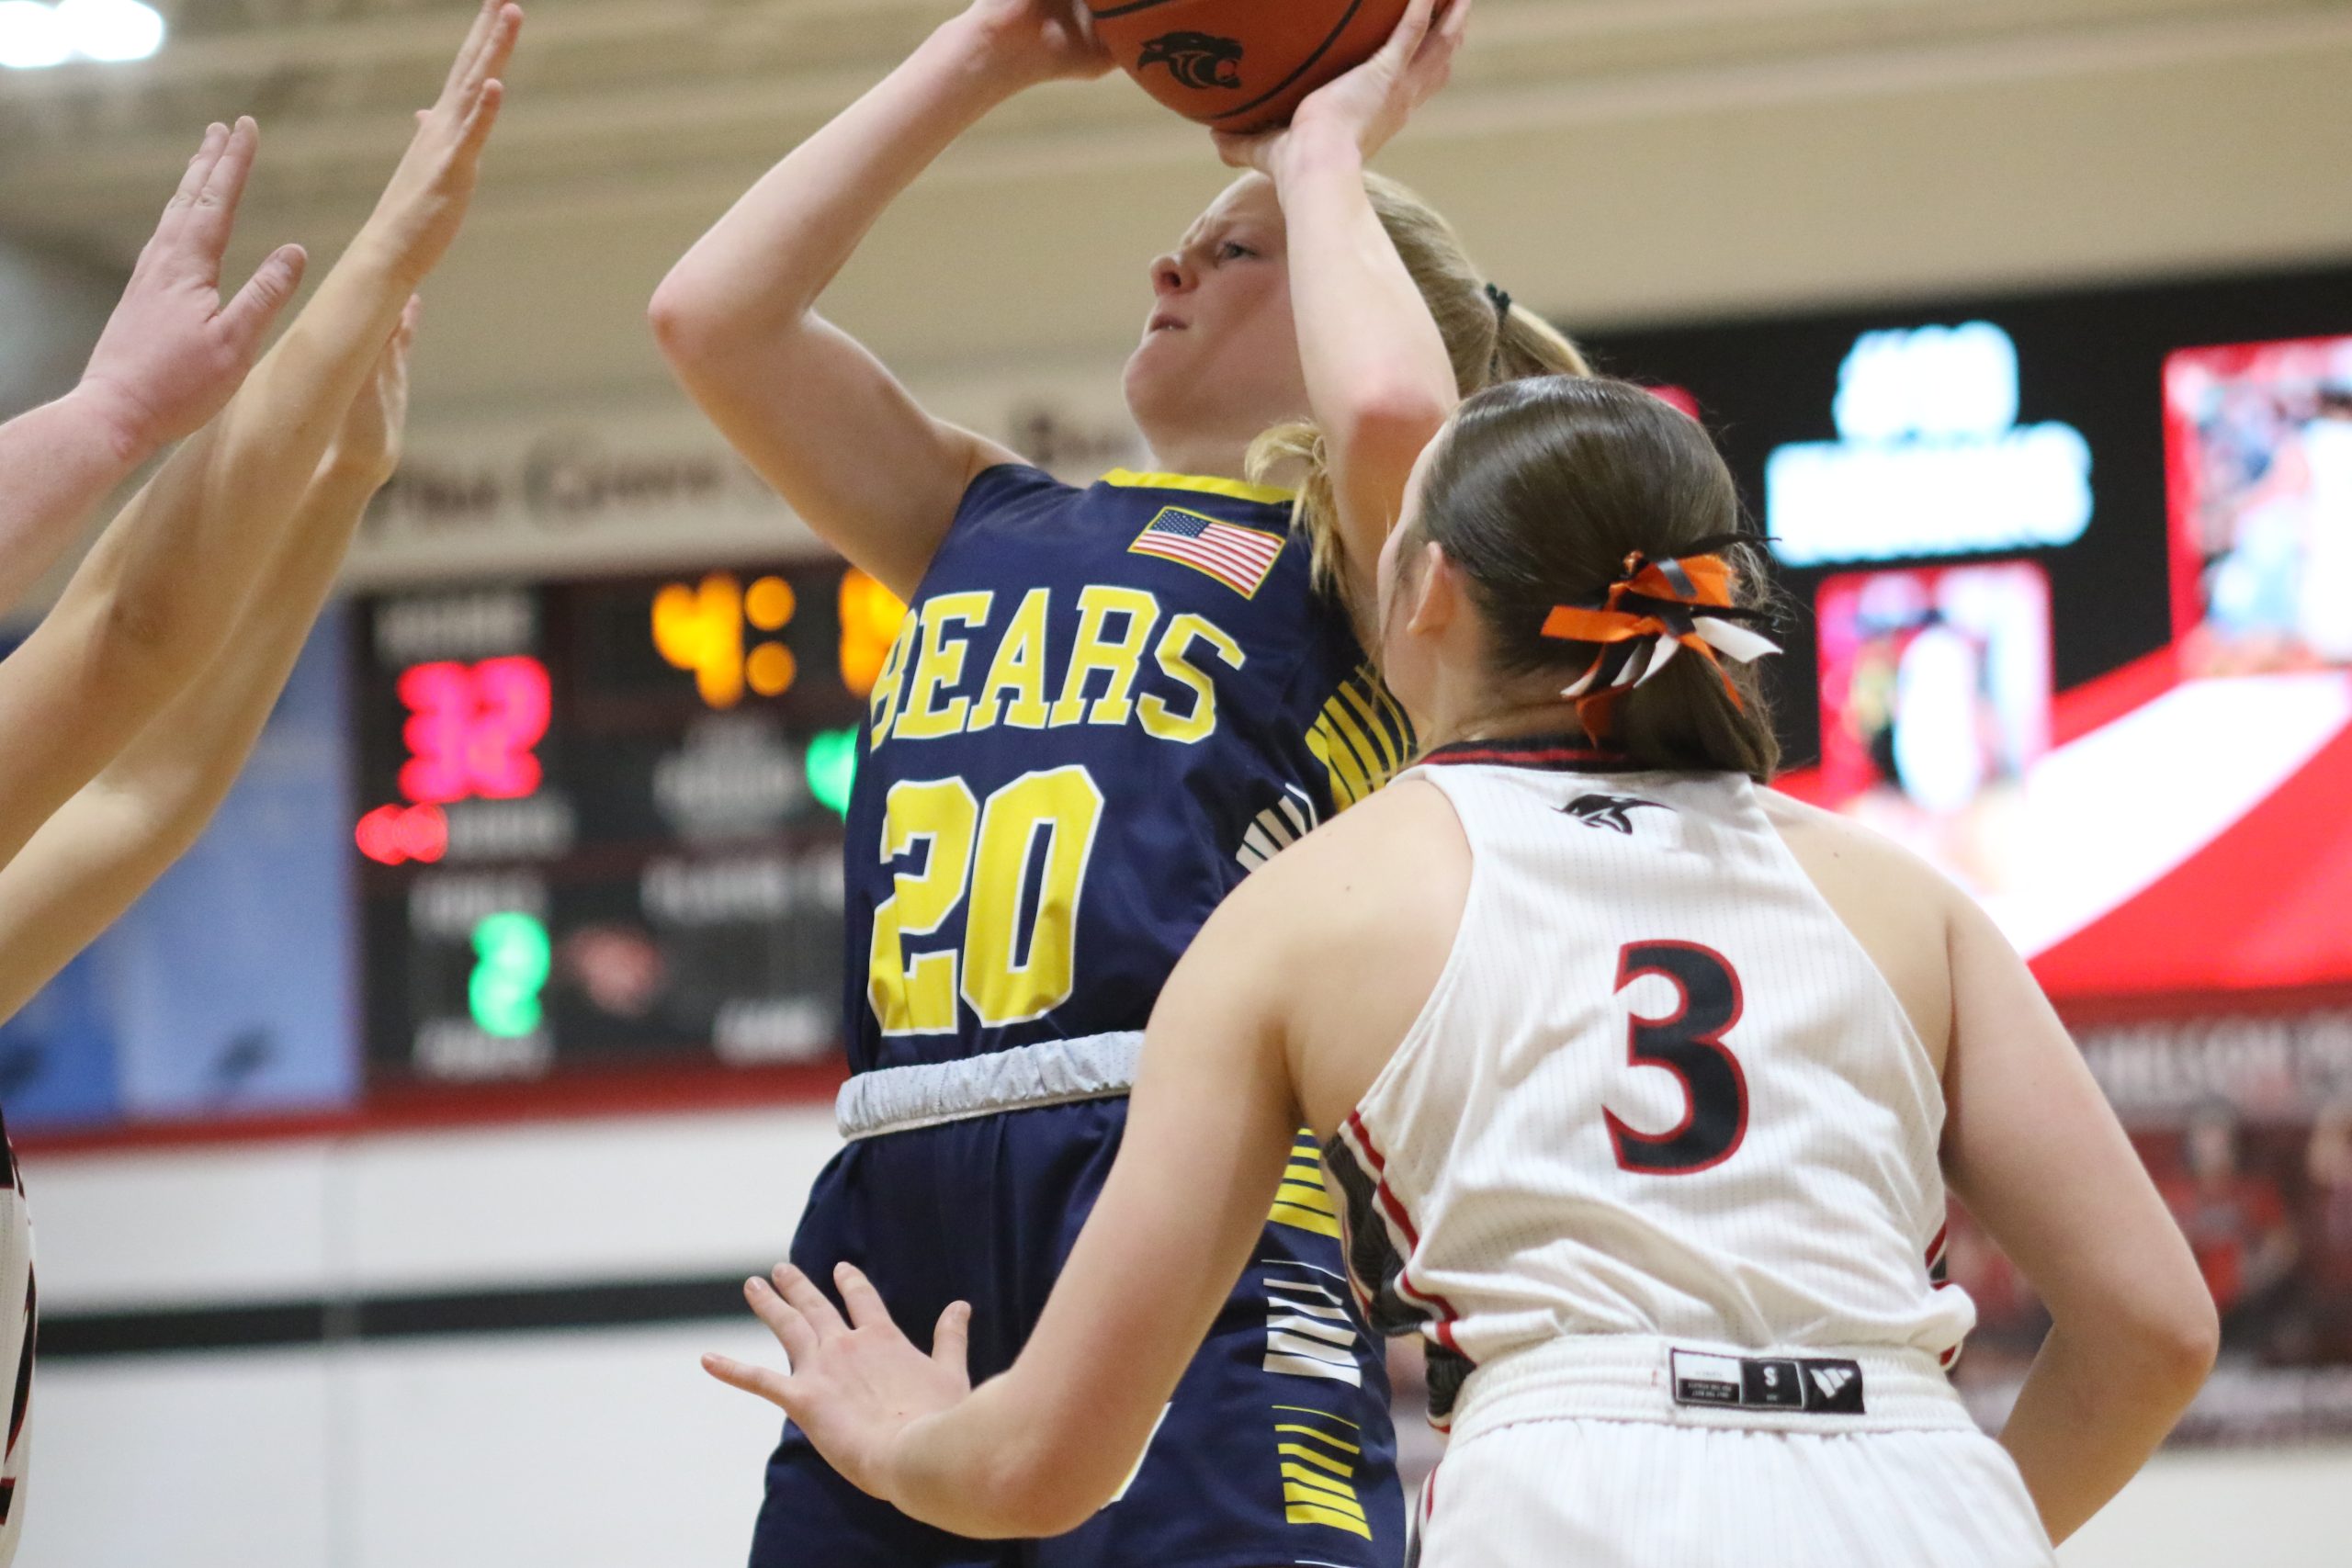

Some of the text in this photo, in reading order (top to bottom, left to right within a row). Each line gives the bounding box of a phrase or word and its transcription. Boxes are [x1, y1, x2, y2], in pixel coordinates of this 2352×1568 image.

[397, 655, 552, 803] 32
[866, 764, 1105, 1037] 20
[1600, 938, 1749, 1176] 3
[1763, 1366, 1778, 1387] S
